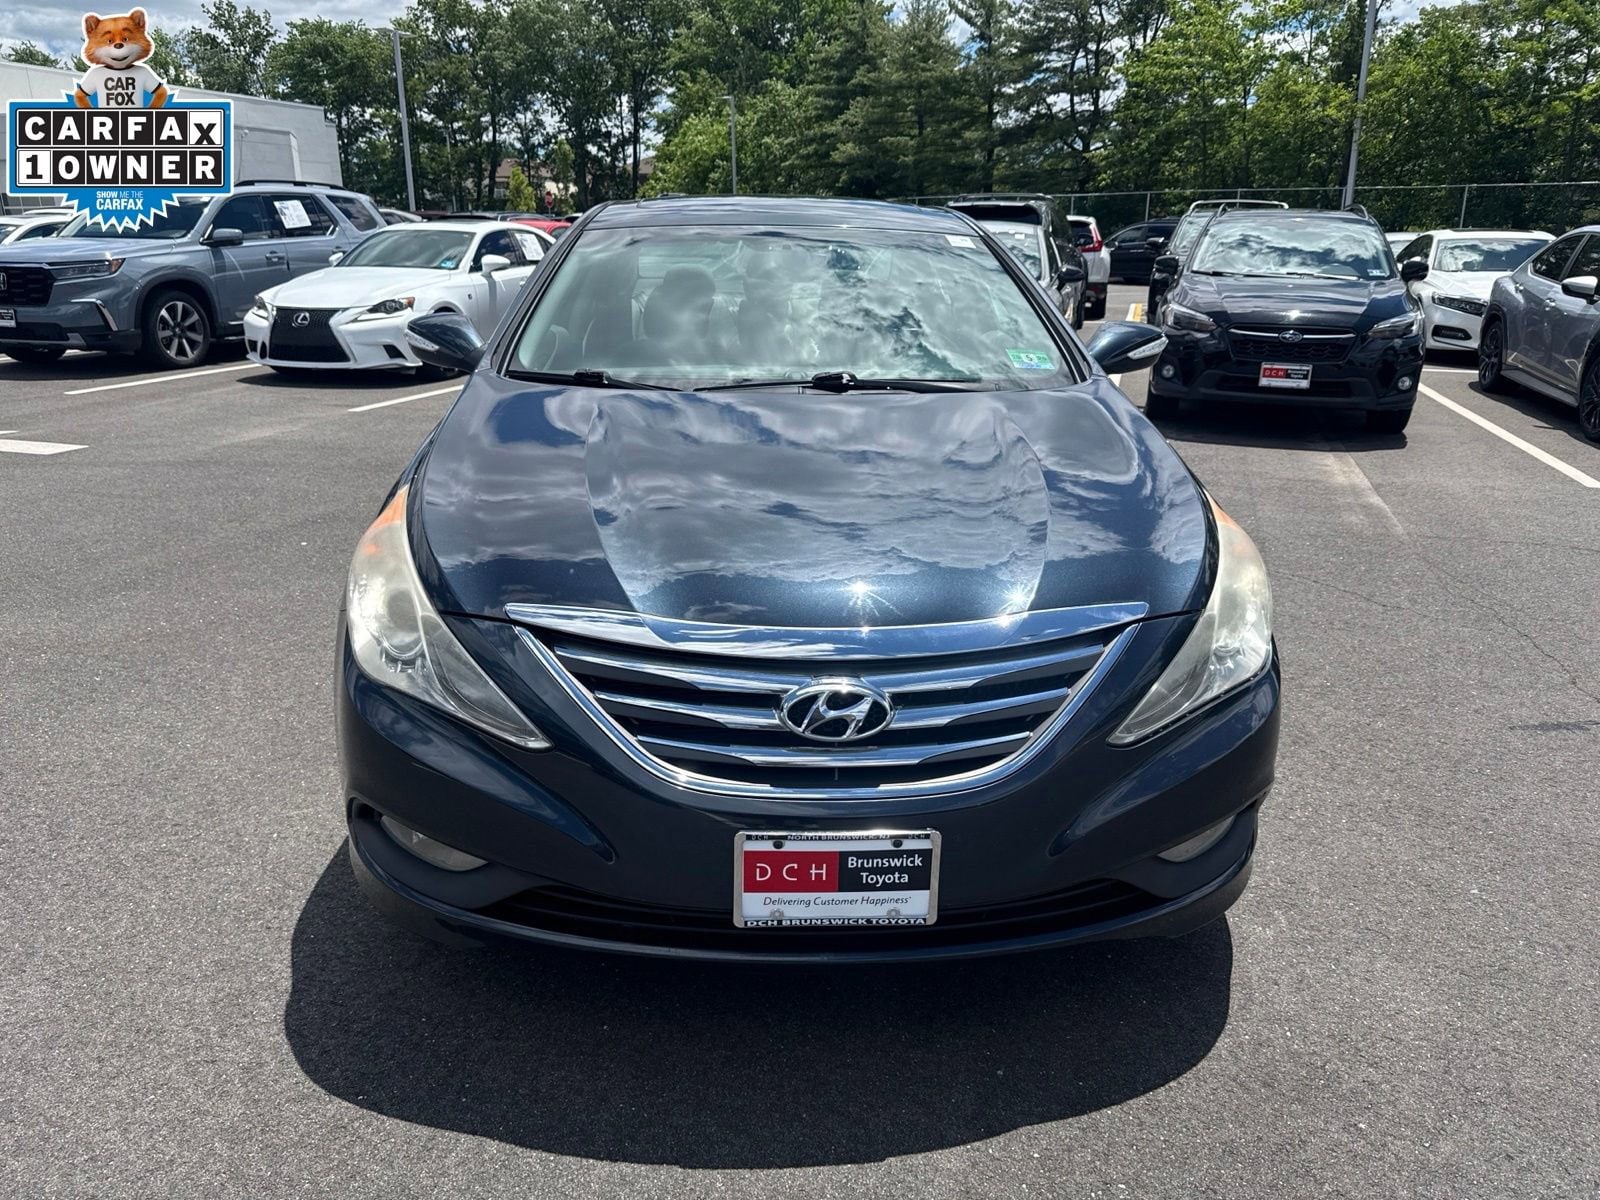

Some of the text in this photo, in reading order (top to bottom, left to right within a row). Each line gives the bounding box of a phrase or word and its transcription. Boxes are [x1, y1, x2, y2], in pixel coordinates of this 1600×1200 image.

[847, 854, 923, 868] Brunswick
[860, 872, 909, 887] Toyota
[763, 896, 811, 908] Delivering
[813, 896, 858, 906] Customer
[782, 918, 867, 926] BRUNSWICK
